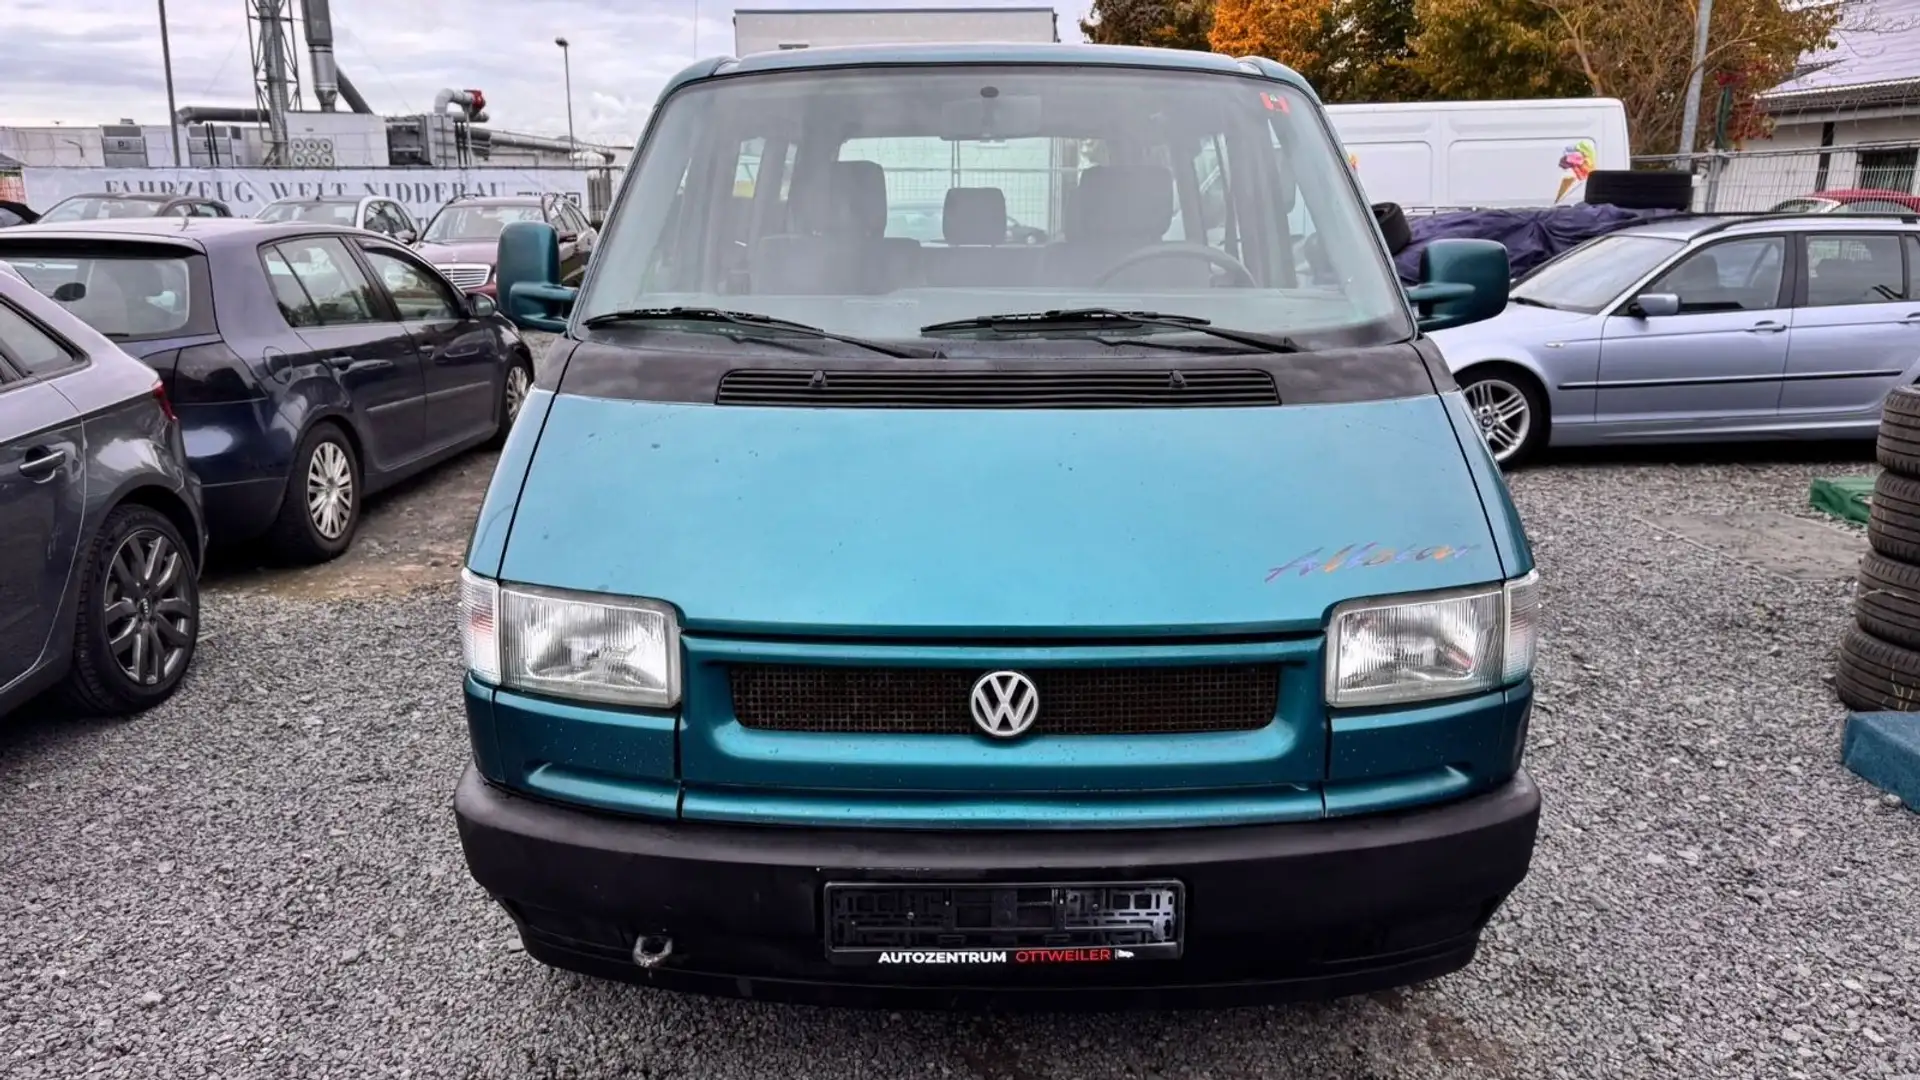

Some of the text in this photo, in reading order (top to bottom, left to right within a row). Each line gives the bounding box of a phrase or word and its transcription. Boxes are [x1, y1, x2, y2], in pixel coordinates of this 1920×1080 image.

[105, 180, 254, 203] FAHRZEUG
[269, 181, 349, 200] WELT
[970, 670, 1040, 737] VW
[877, 948, 1113, 964] AUTOZENTRUM OTTWEILER
